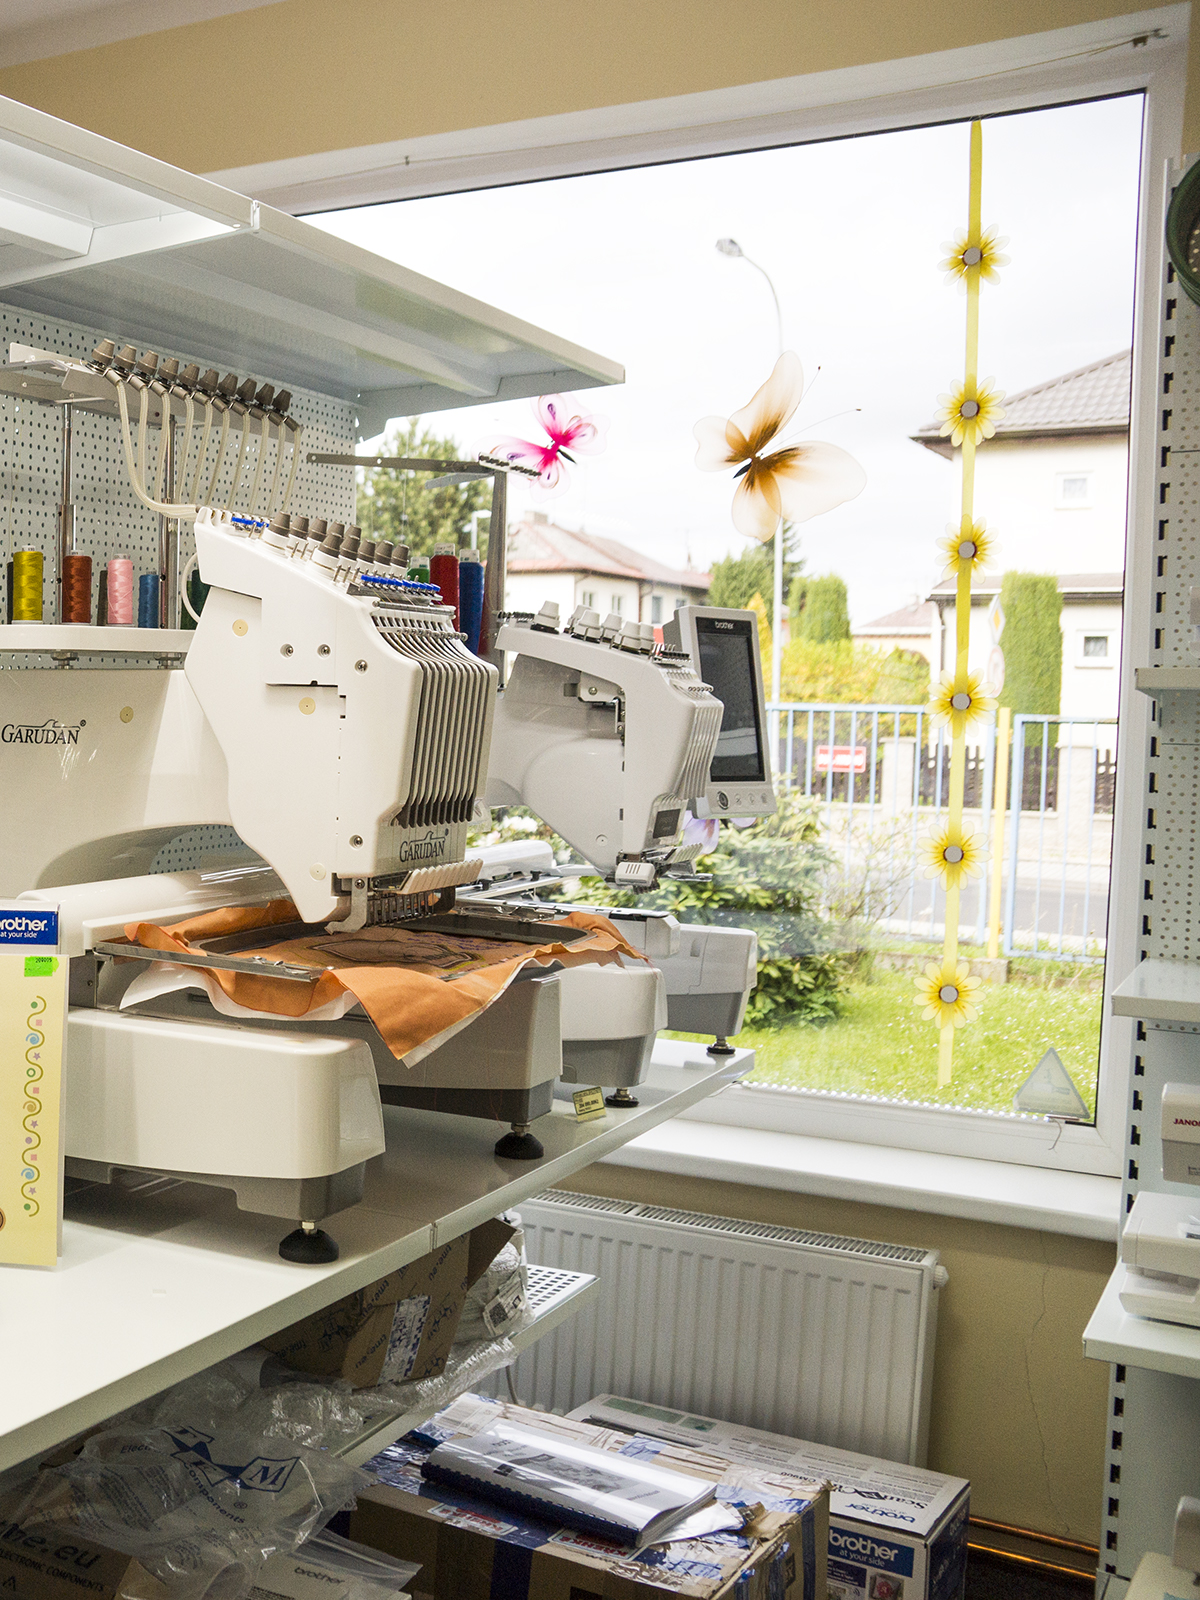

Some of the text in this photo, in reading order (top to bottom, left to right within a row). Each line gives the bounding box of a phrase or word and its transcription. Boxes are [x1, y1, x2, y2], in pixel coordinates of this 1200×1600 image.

[0, 723, 80, 746] GARUDAN
[400, 838, 446, 864] GARUDAN
[8, 932, 22, 940] your
[1173, 1117, 1200, 1128] JANO
[427, 1244, 453, 1282] tme.eu
[354, 1333, 388, 1369] tme.eu
[248, 1466, 288, 1486] M
[844, 1502, 916, 1524] brother
[829, 1528, 899, 1562] brother
[838, 1550, 886, 1568] at your side
[46, 1566, 105, 1593] COMPONENTS
[294, 1566, 346, 1584] brother
